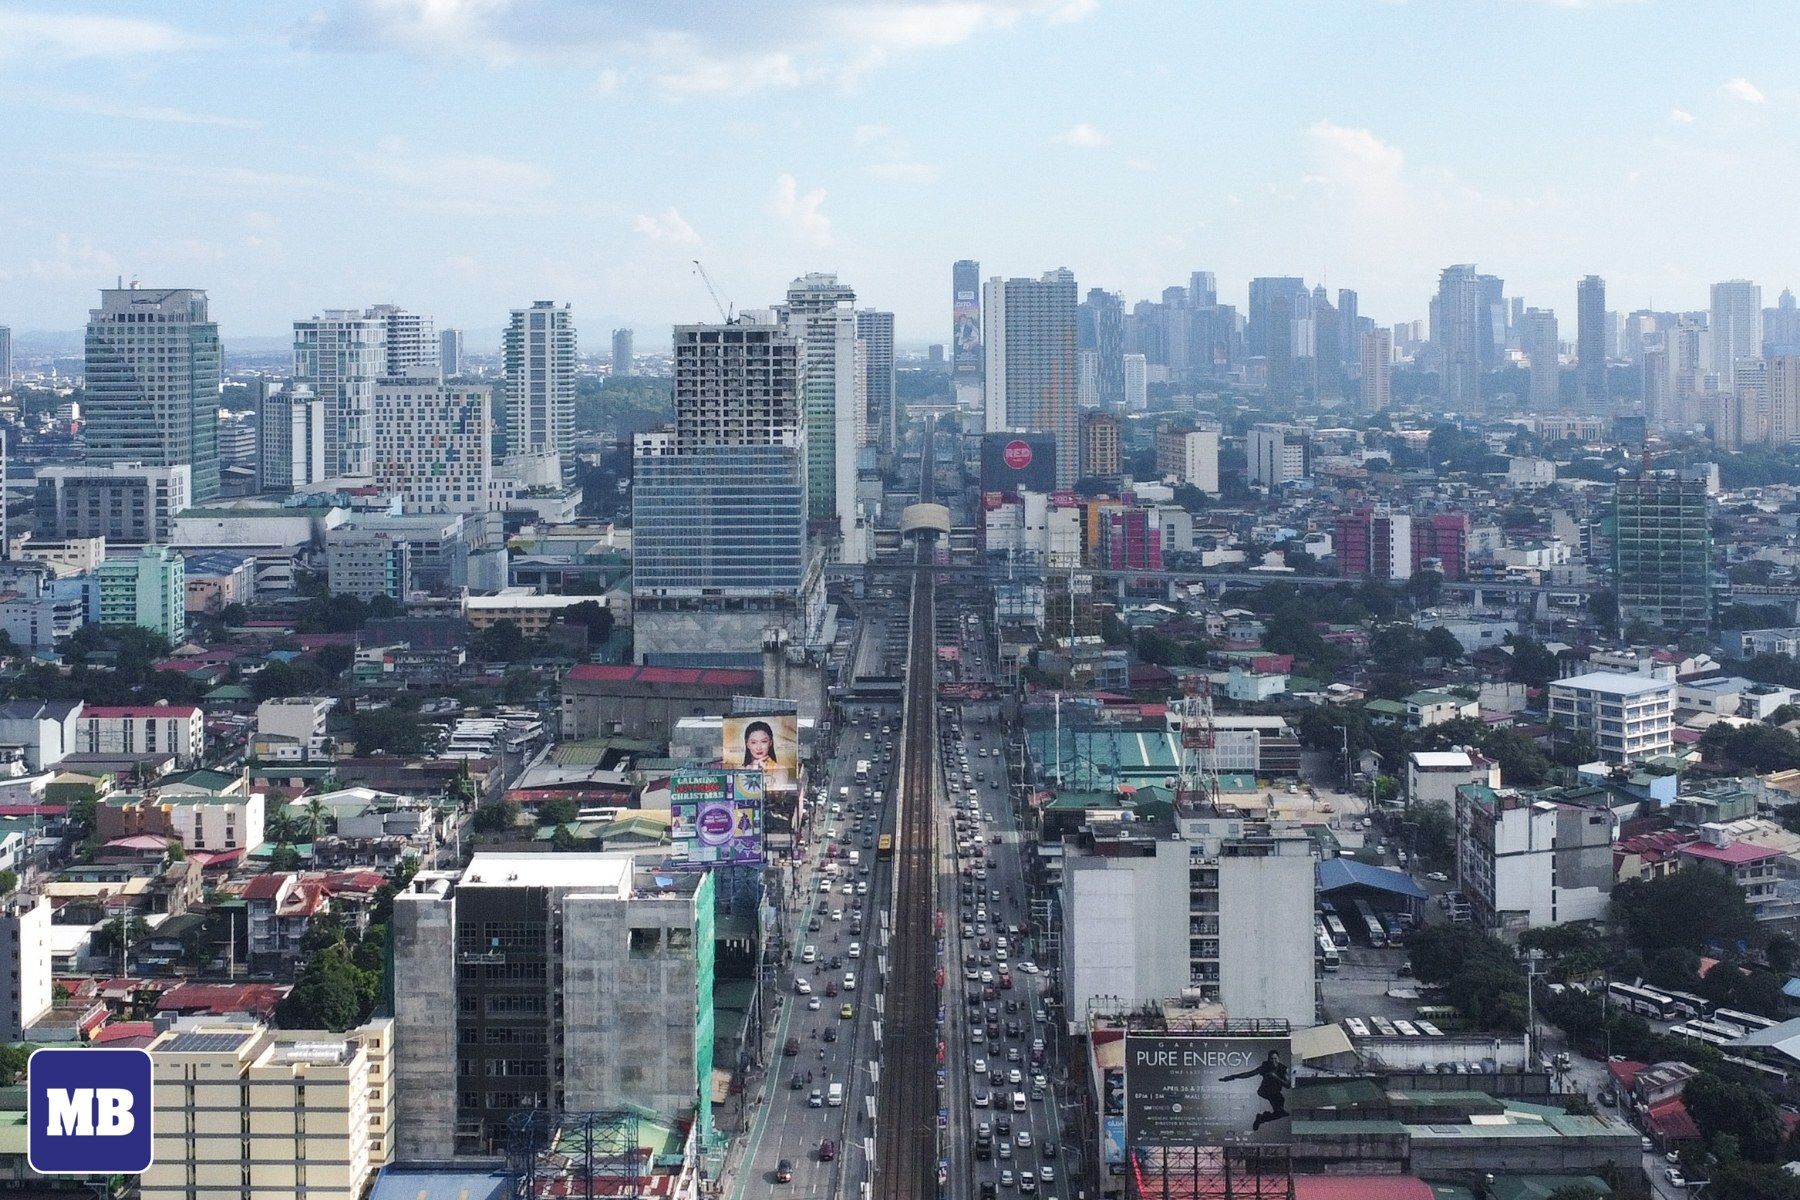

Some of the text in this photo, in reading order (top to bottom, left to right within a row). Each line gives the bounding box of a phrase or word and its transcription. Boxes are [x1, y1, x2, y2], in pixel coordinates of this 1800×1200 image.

[671, 791, 724, 800] CHRISTMAS
[1136, 1051, 1253, 1066] PURE ENERGY
